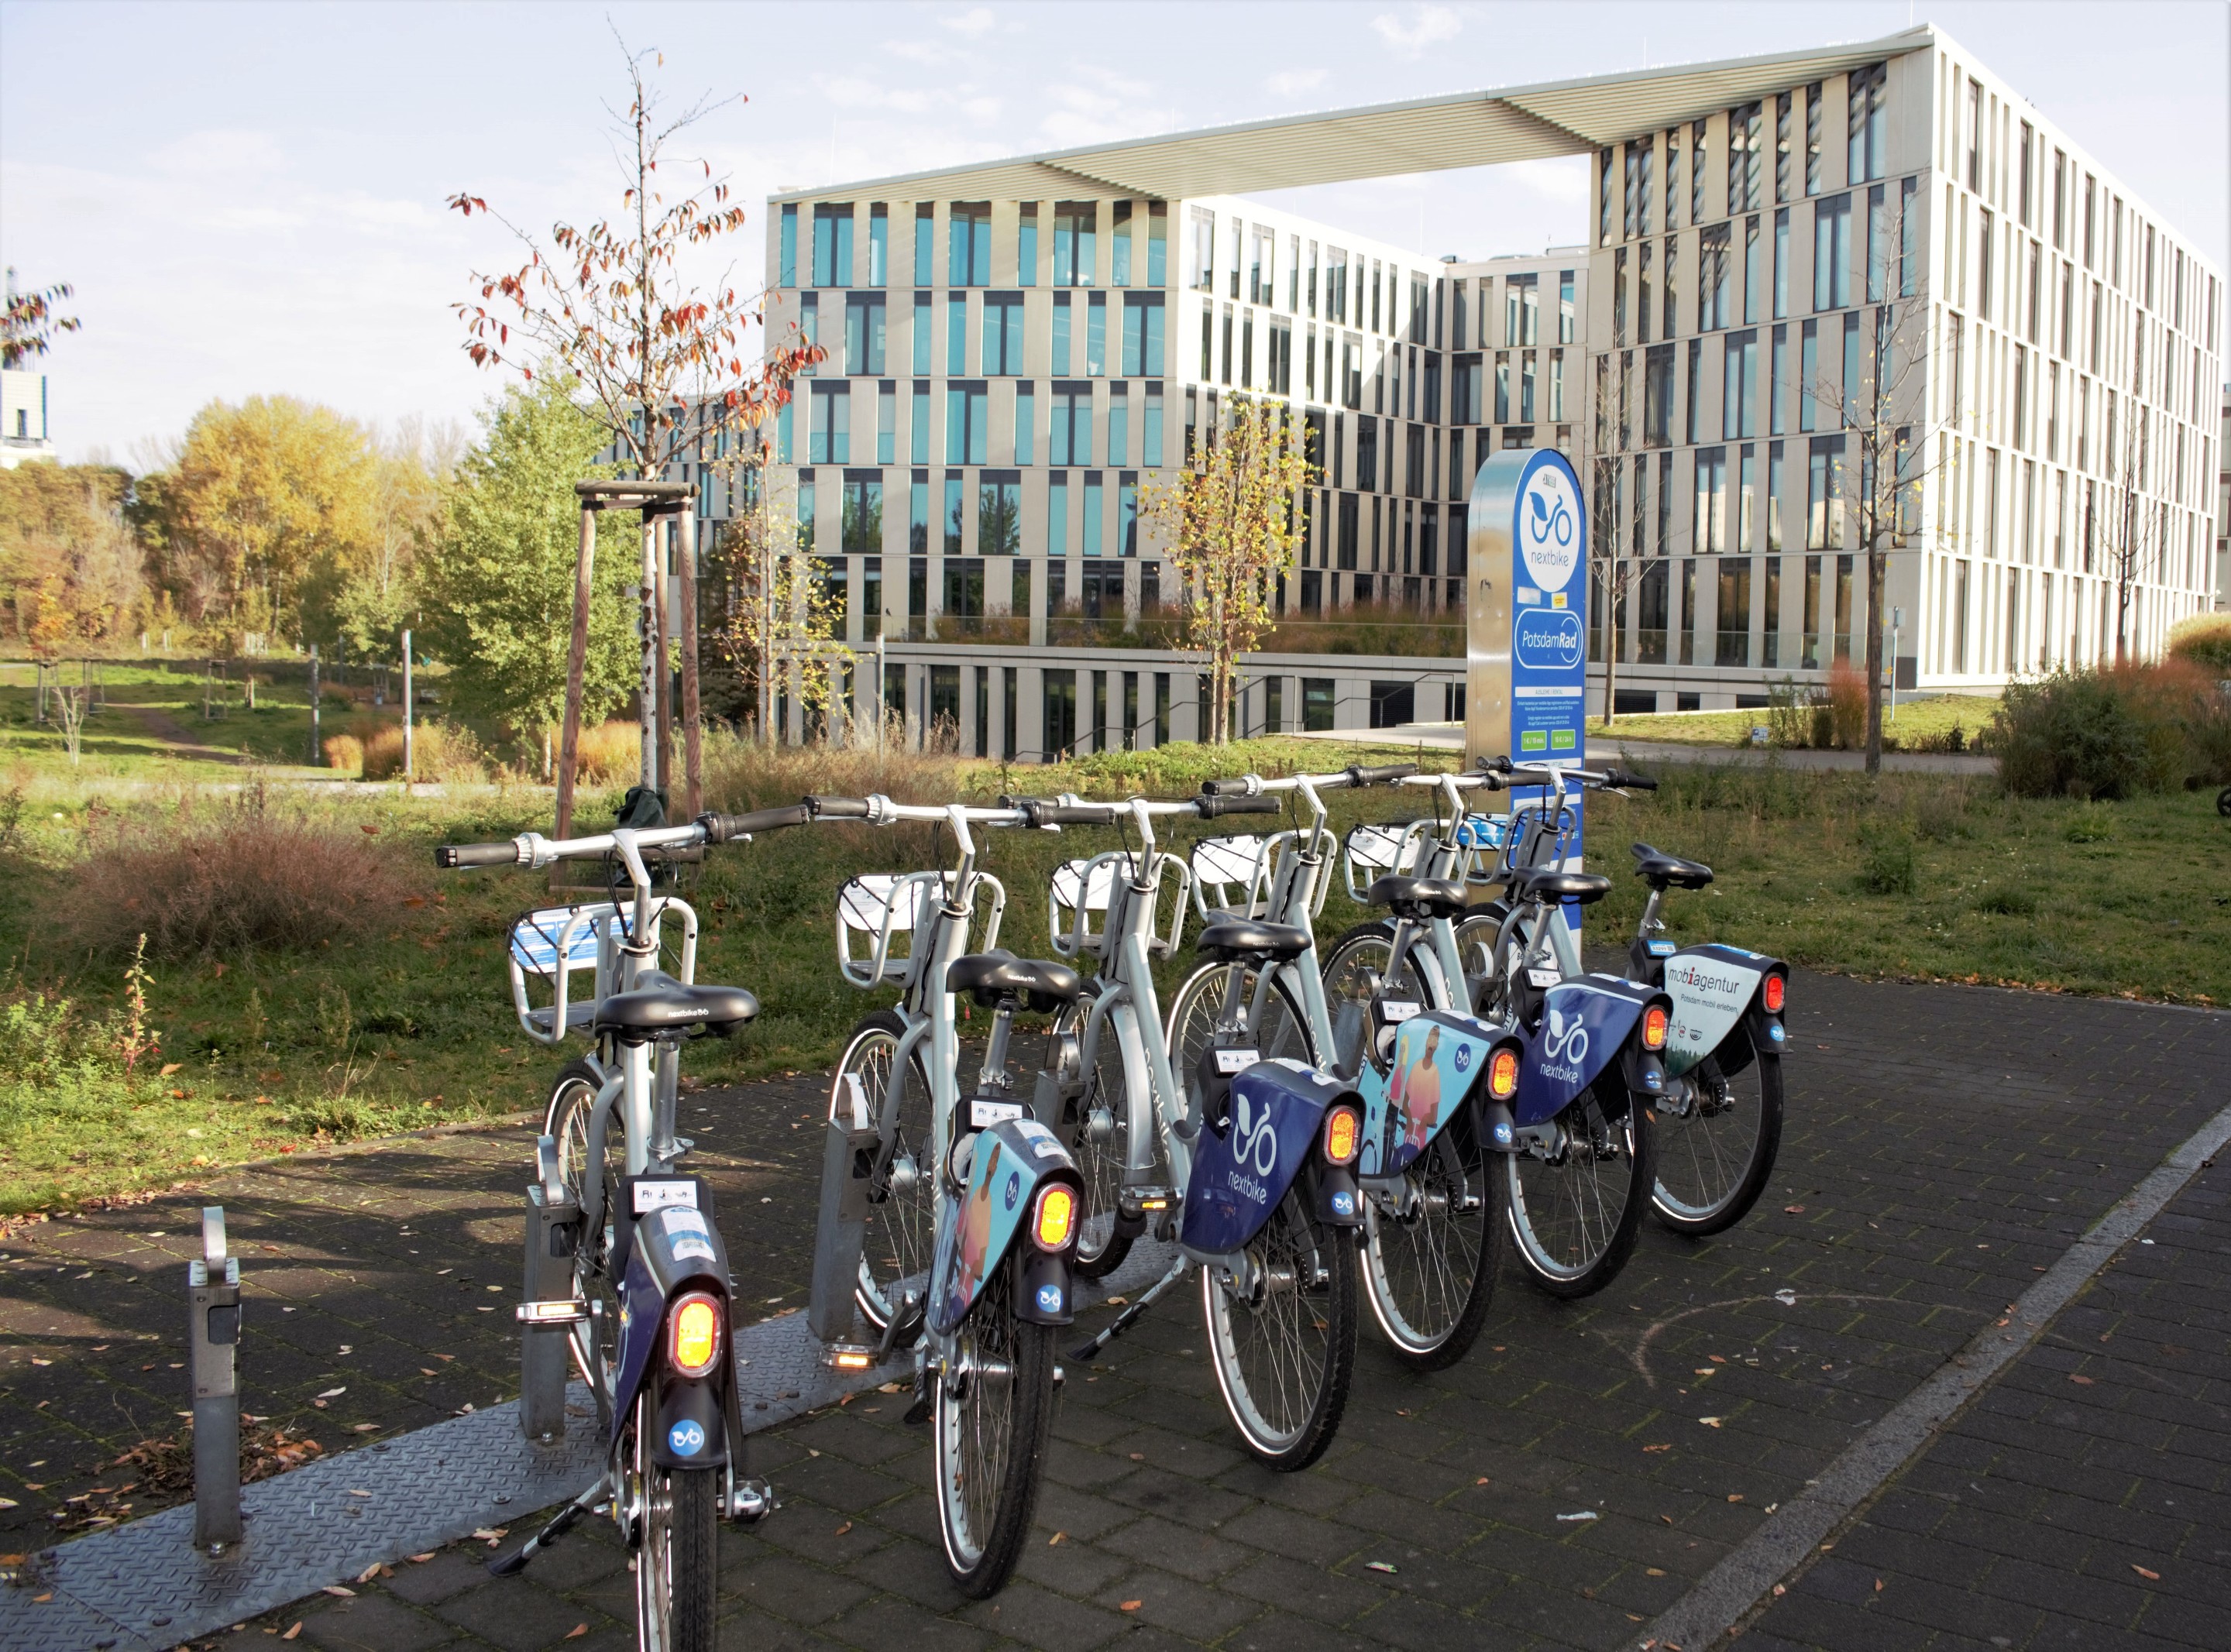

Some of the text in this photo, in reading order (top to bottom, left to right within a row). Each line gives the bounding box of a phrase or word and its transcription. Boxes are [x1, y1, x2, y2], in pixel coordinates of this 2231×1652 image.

[1531, 549, 1569, 567] nextbike
[1522, 630, 1578, 649] PotsdamRad
[1668, 967, 1740, 994] mobiagentur
[1680, 994, 1701, 1006] Potsdam
[1701, 999, 1716, 1008] mobil
[668, 1009, 698, 1018] nextbike
[1540, 1063, 1579, 1084] nextbike
[1228, 1170, 1267, 1205] nextbike
